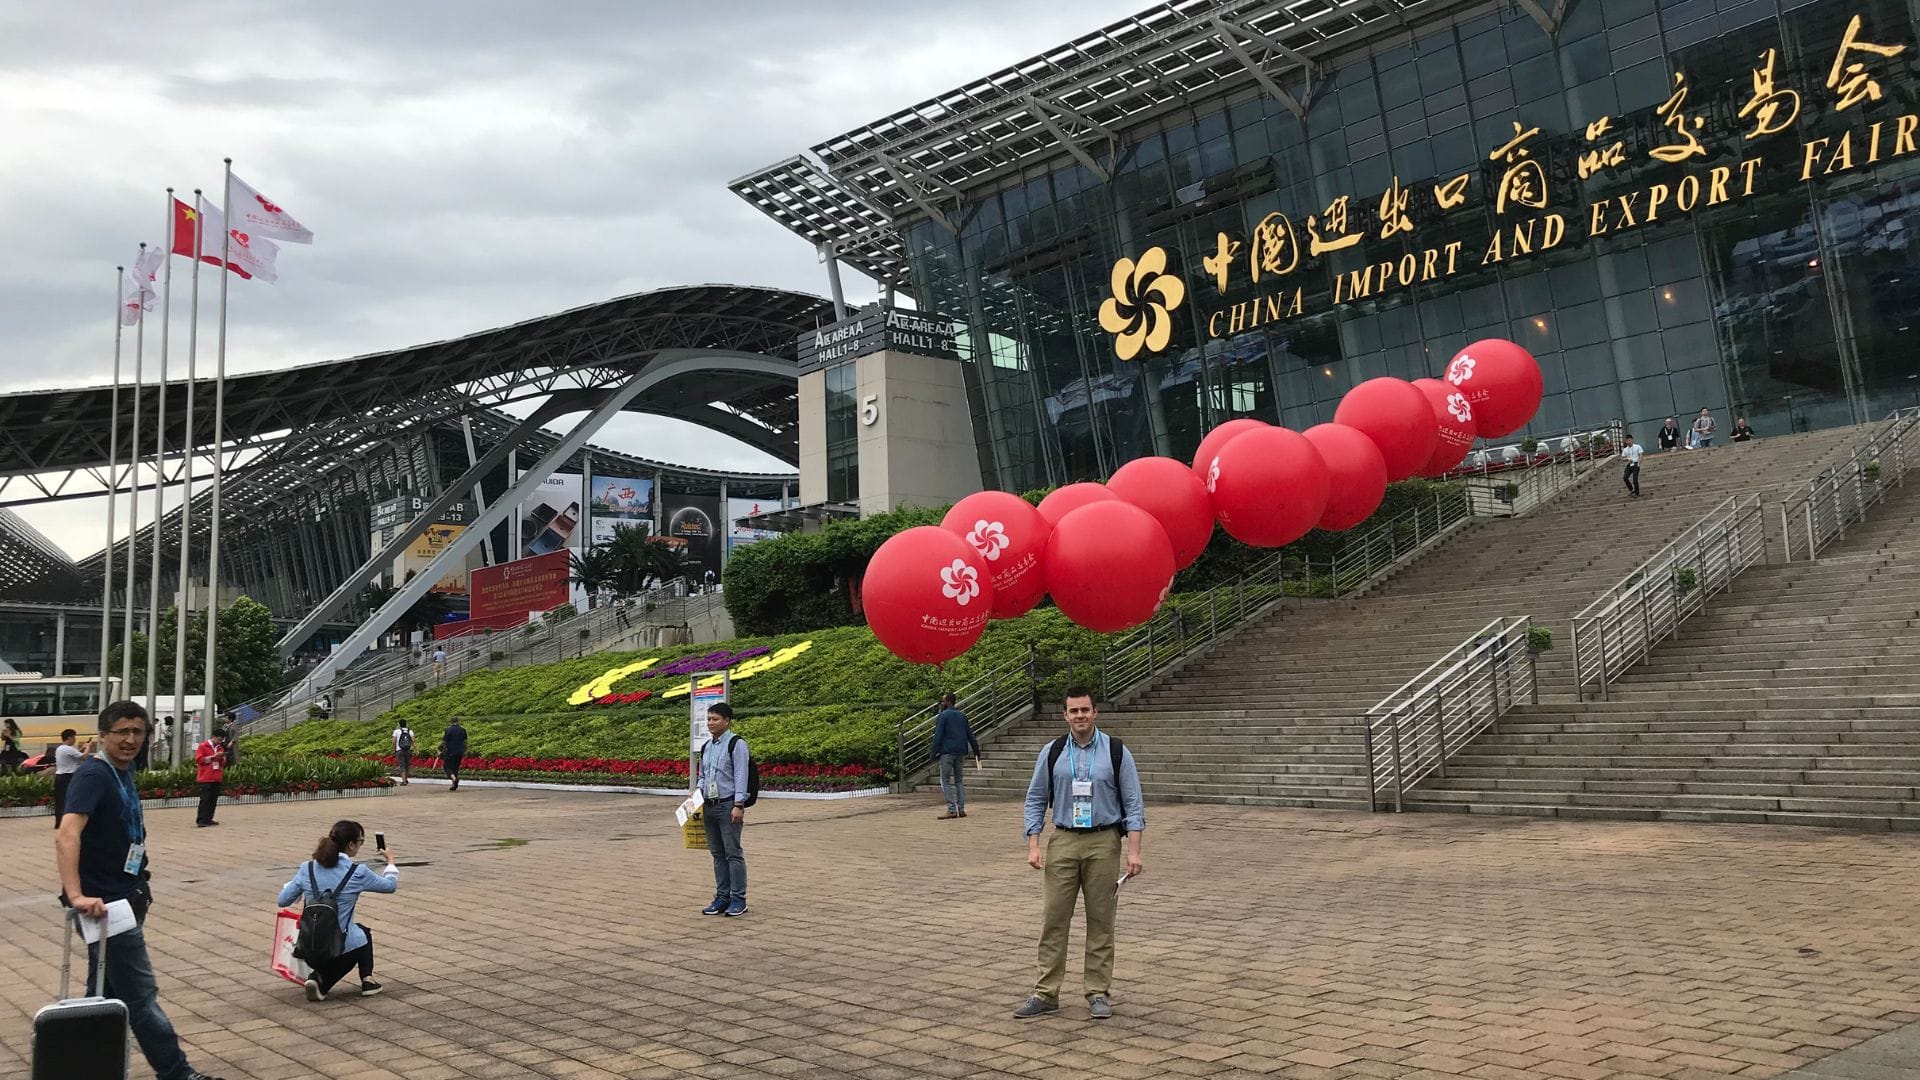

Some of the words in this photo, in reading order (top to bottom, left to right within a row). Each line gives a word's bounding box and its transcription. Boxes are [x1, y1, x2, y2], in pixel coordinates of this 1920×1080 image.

[1209, 287, 1304, 338] CHINA
[1334, 240, 1462, 305] IMPORT
[1481, 214, 1566, 266] AND
[1589, 157, 1762, 237] EXPORT
[1798, 114, 1920, 182] FAIR
[861, 394, 879, 426] 5
